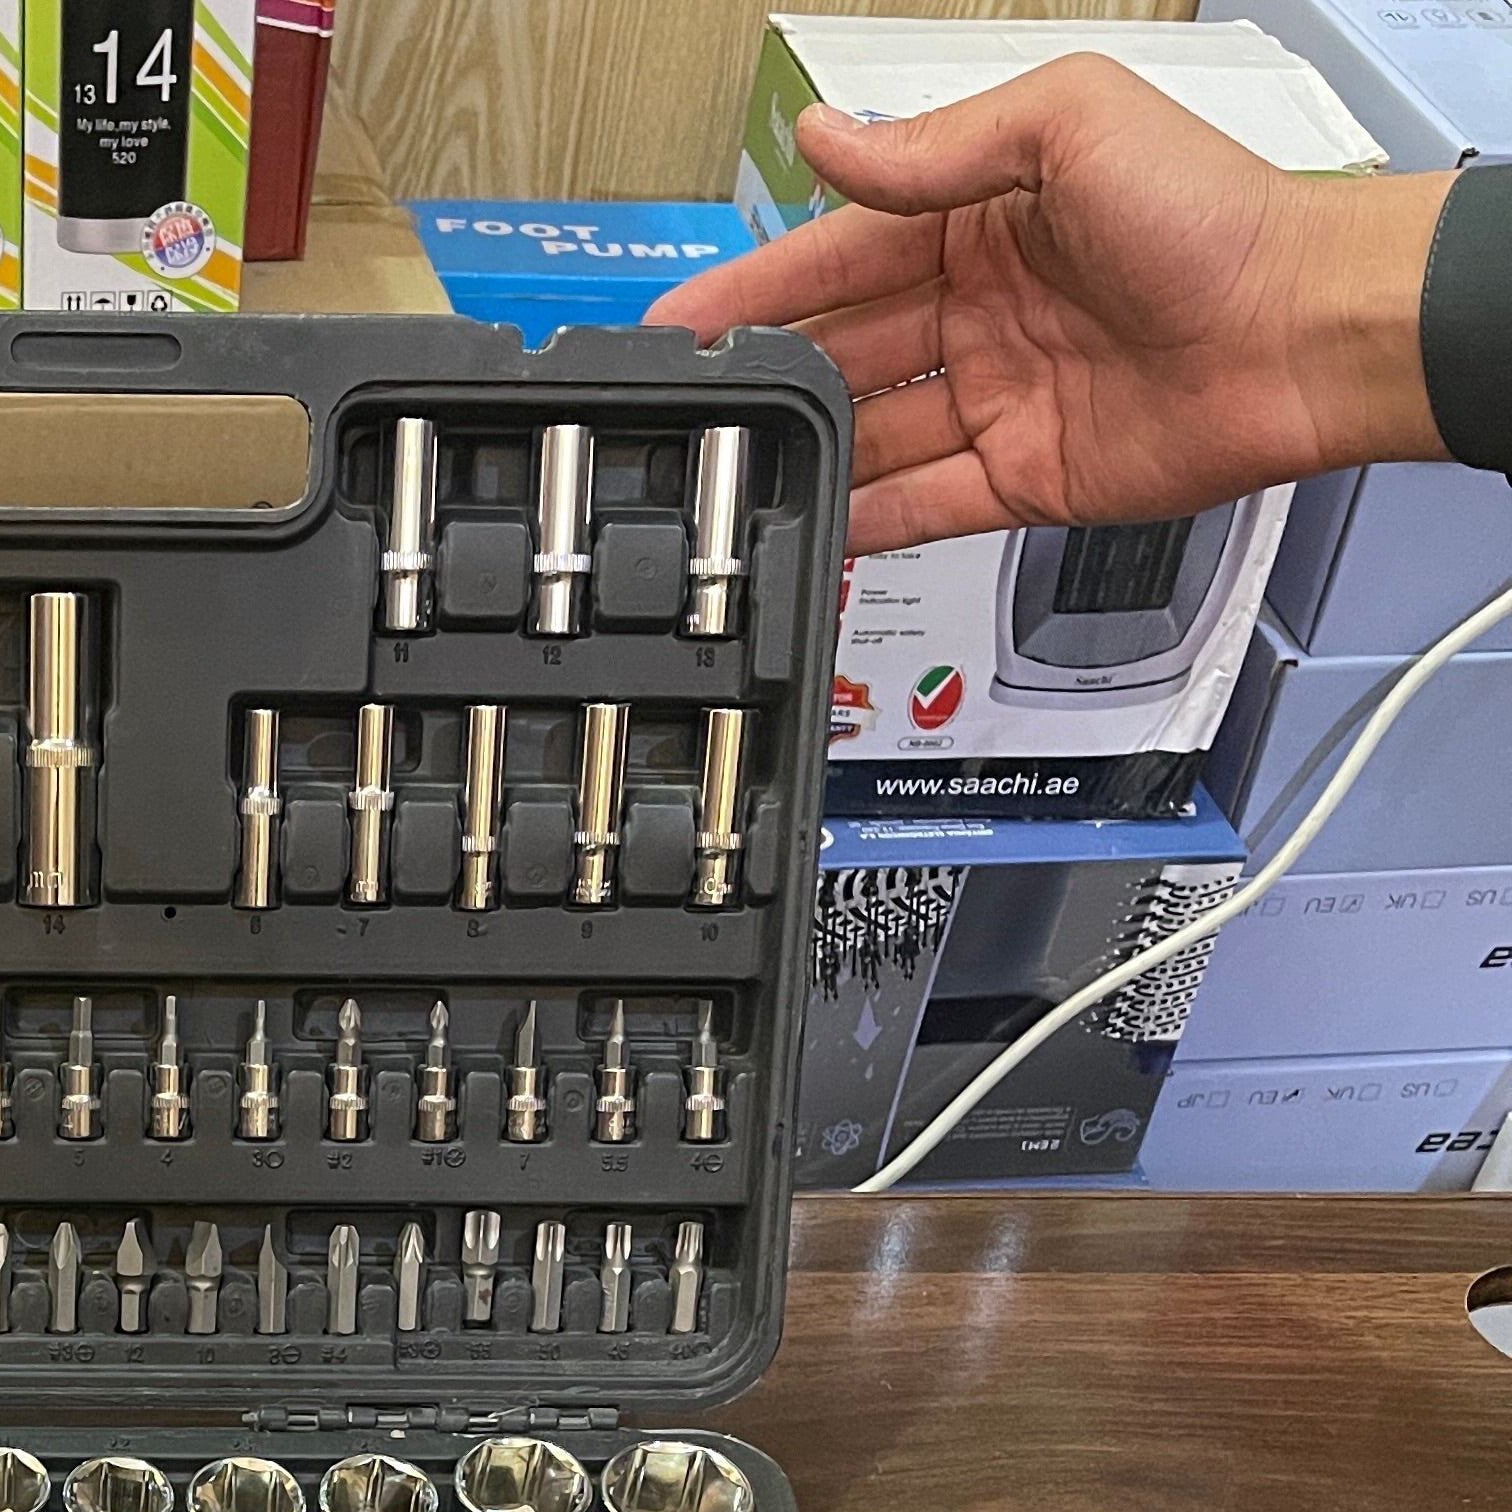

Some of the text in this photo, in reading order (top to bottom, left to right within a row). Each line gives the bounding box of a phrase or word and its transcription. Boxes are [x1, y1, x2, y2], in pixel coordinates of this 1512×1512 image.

[74, 28, 177, 105] 13 14
[121, 135, 149, 147] love
[112, 151, 137, 164] 520
[436, 218, 599, 241] FOOT
[541, 240, 719, 259] PUMP
[394, 645, 409, 662] 11
[541, 647, 561, 664] 12
[876, 771, 1080, 797] www.saachi.ae
[1304, 897, 1337, 916] EU
[1385, 892, 1416, 911] UK
[1466, 889, 1496, 906] US
[43, 915, 64, 935] 14
[699, 922, 718, 942] 10
[161, 1150, 174, 1166] 4
[519, 1154, 530, 1170] 7
